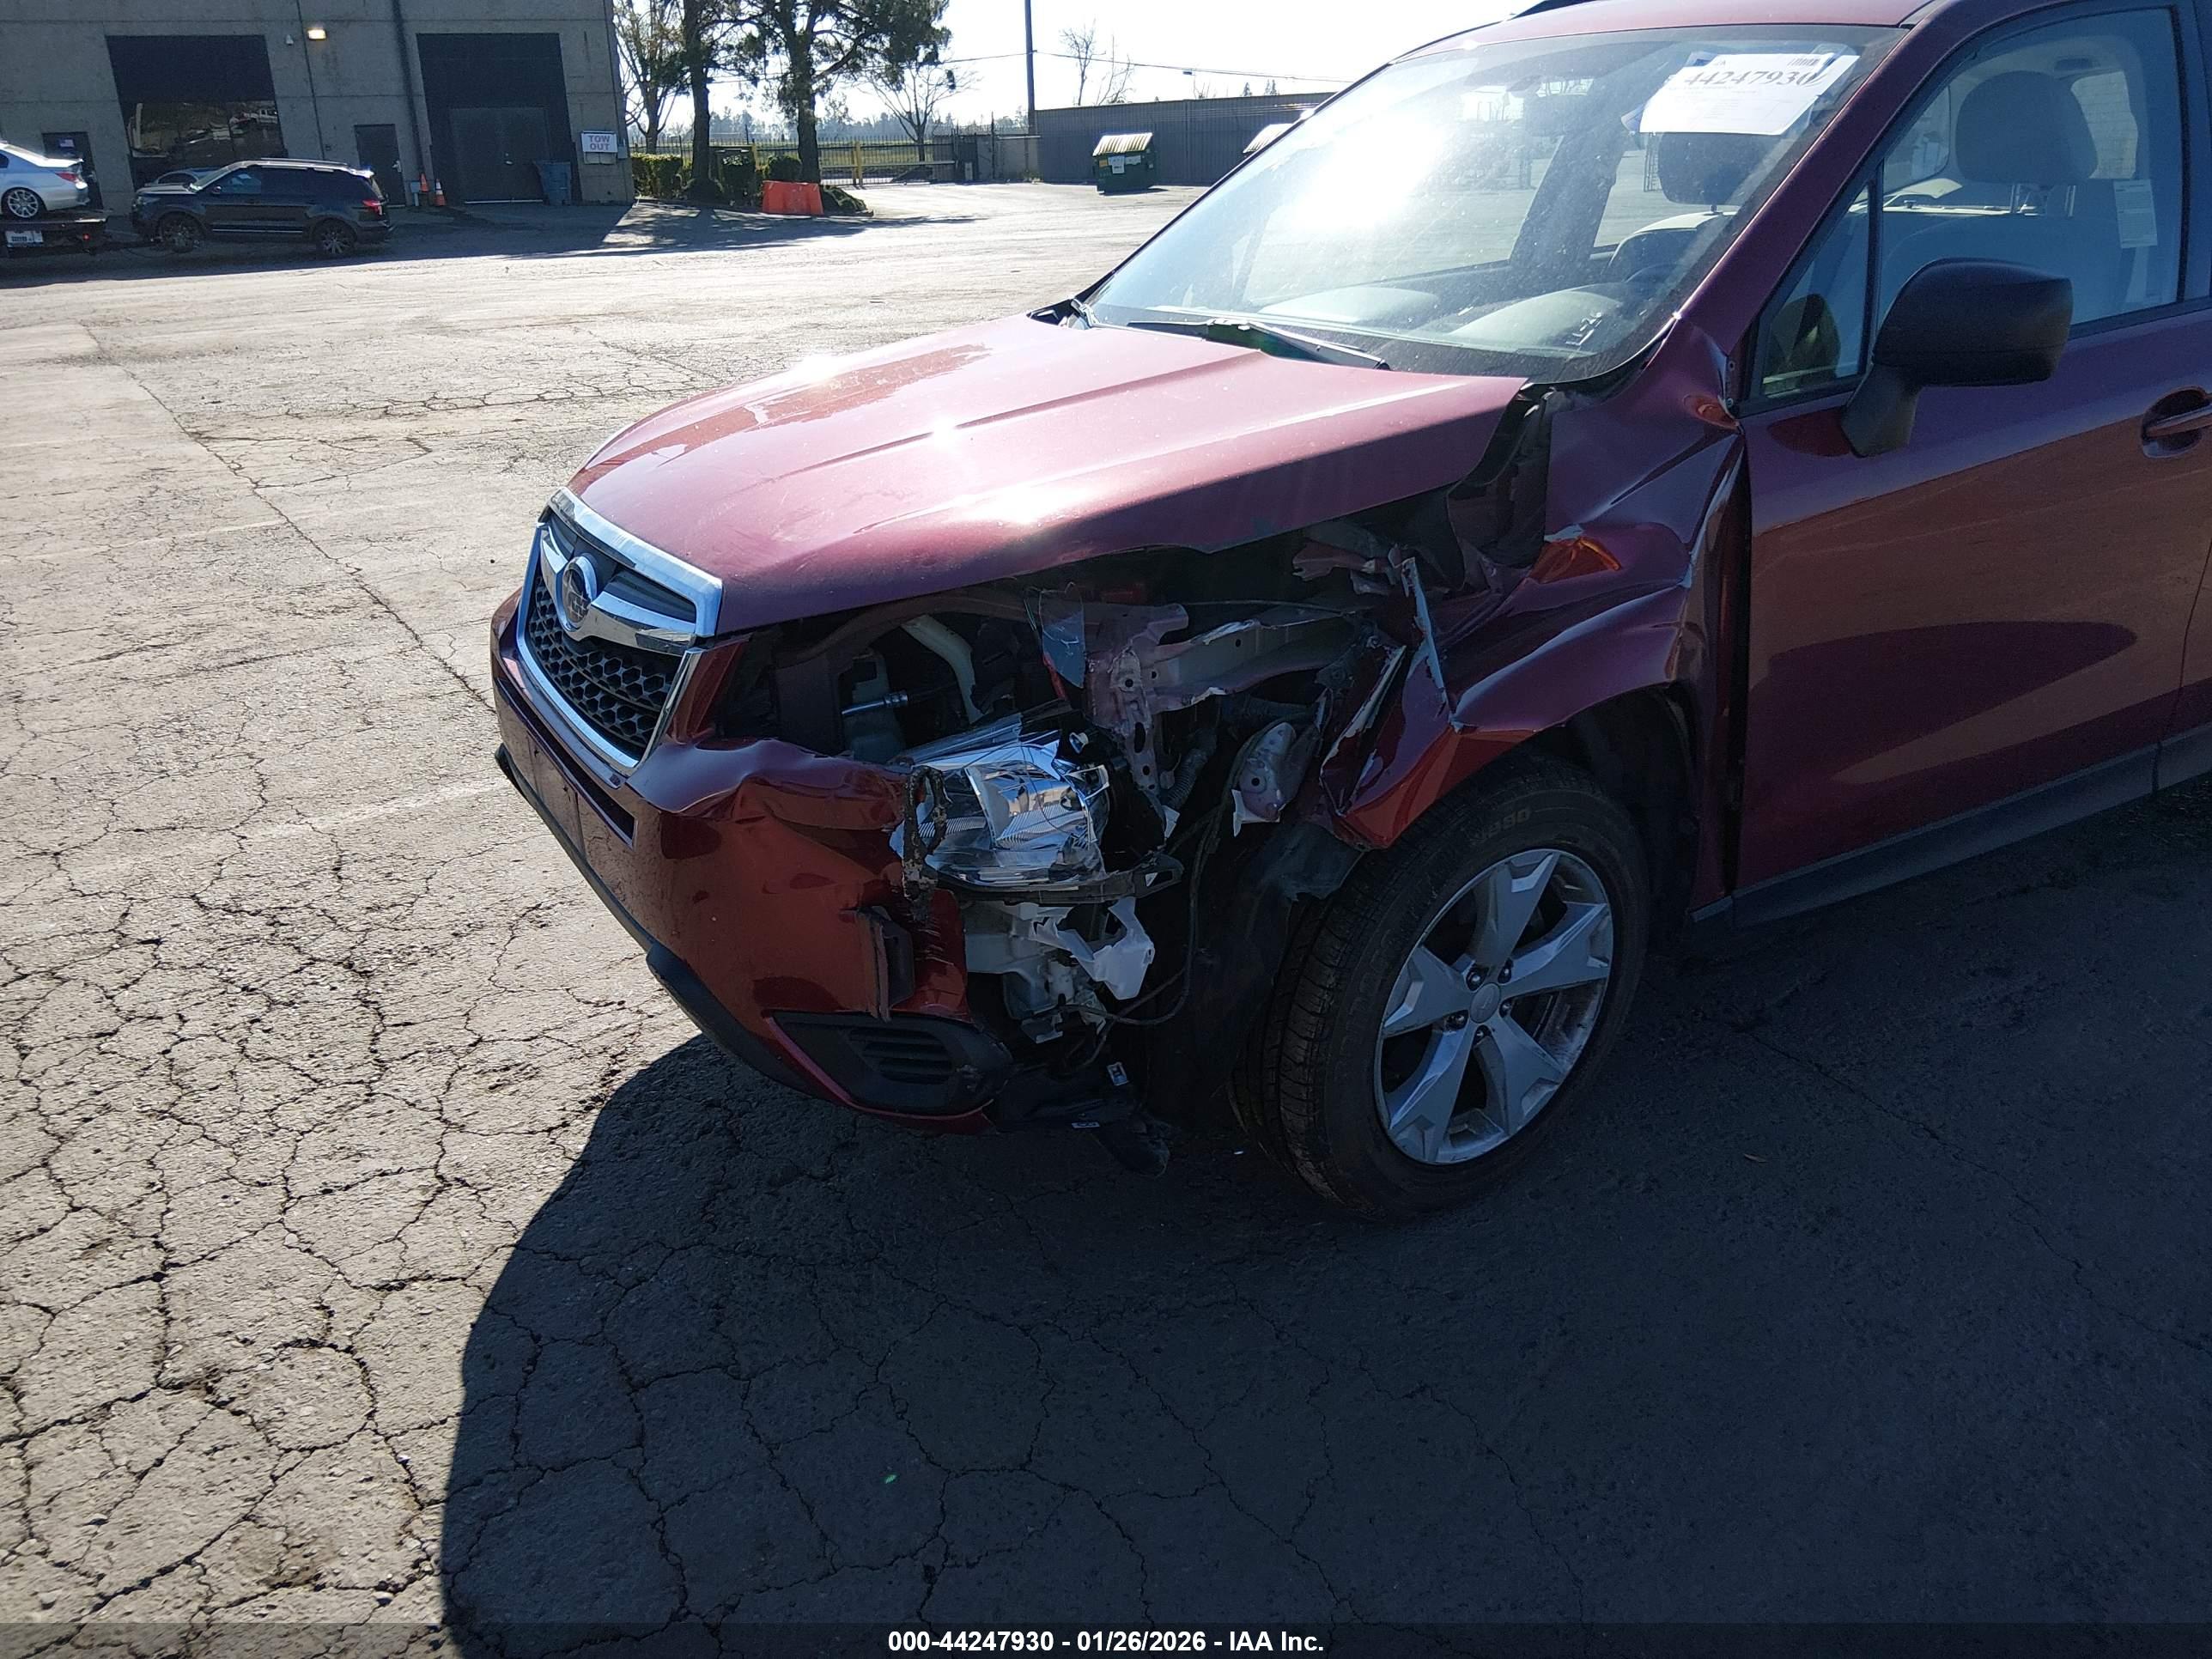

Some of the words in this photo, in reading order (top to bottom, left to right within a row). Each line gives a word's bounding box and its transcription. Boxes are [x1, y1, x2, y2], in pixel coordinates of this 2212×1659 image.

[1684, 70, 1824, 87] 44247930
[589, 135, 611, 143] TOW
[590, 143, 611, 151] OUT
